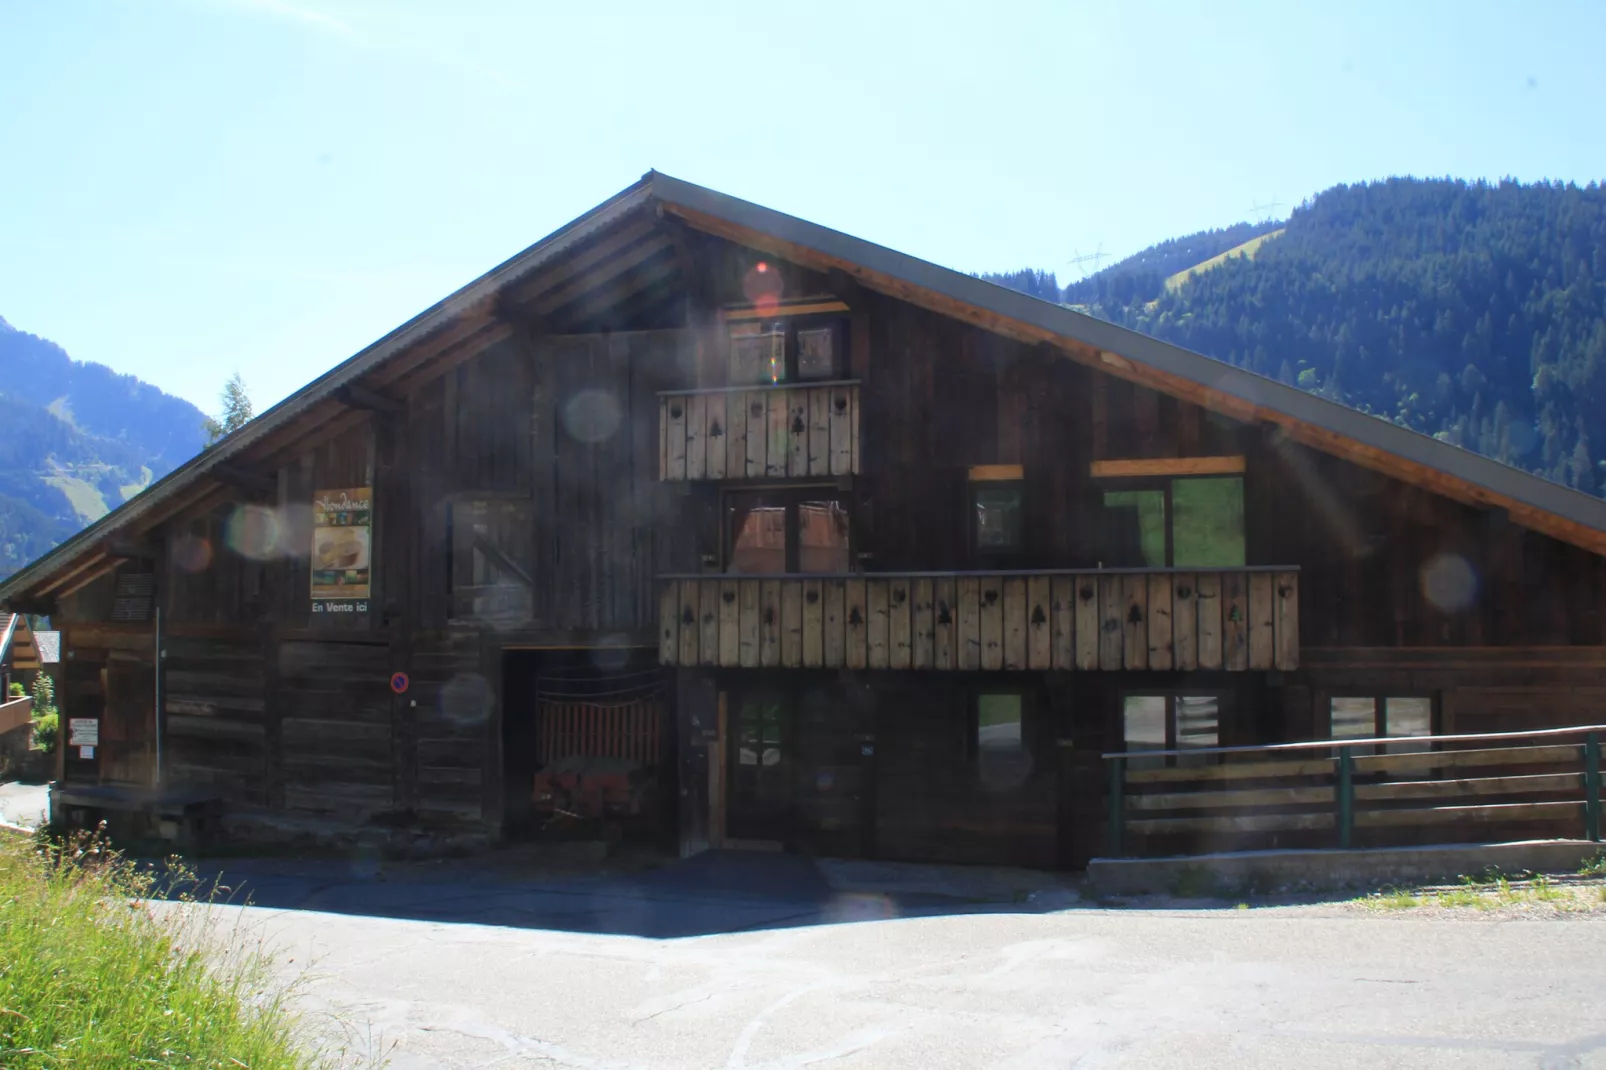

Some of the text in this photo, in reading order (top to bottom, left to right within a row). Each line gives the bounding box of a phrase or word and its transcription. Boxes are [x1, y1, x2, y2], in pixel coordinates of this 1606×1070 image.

[312, 601, 368, 612] En Vente ici
